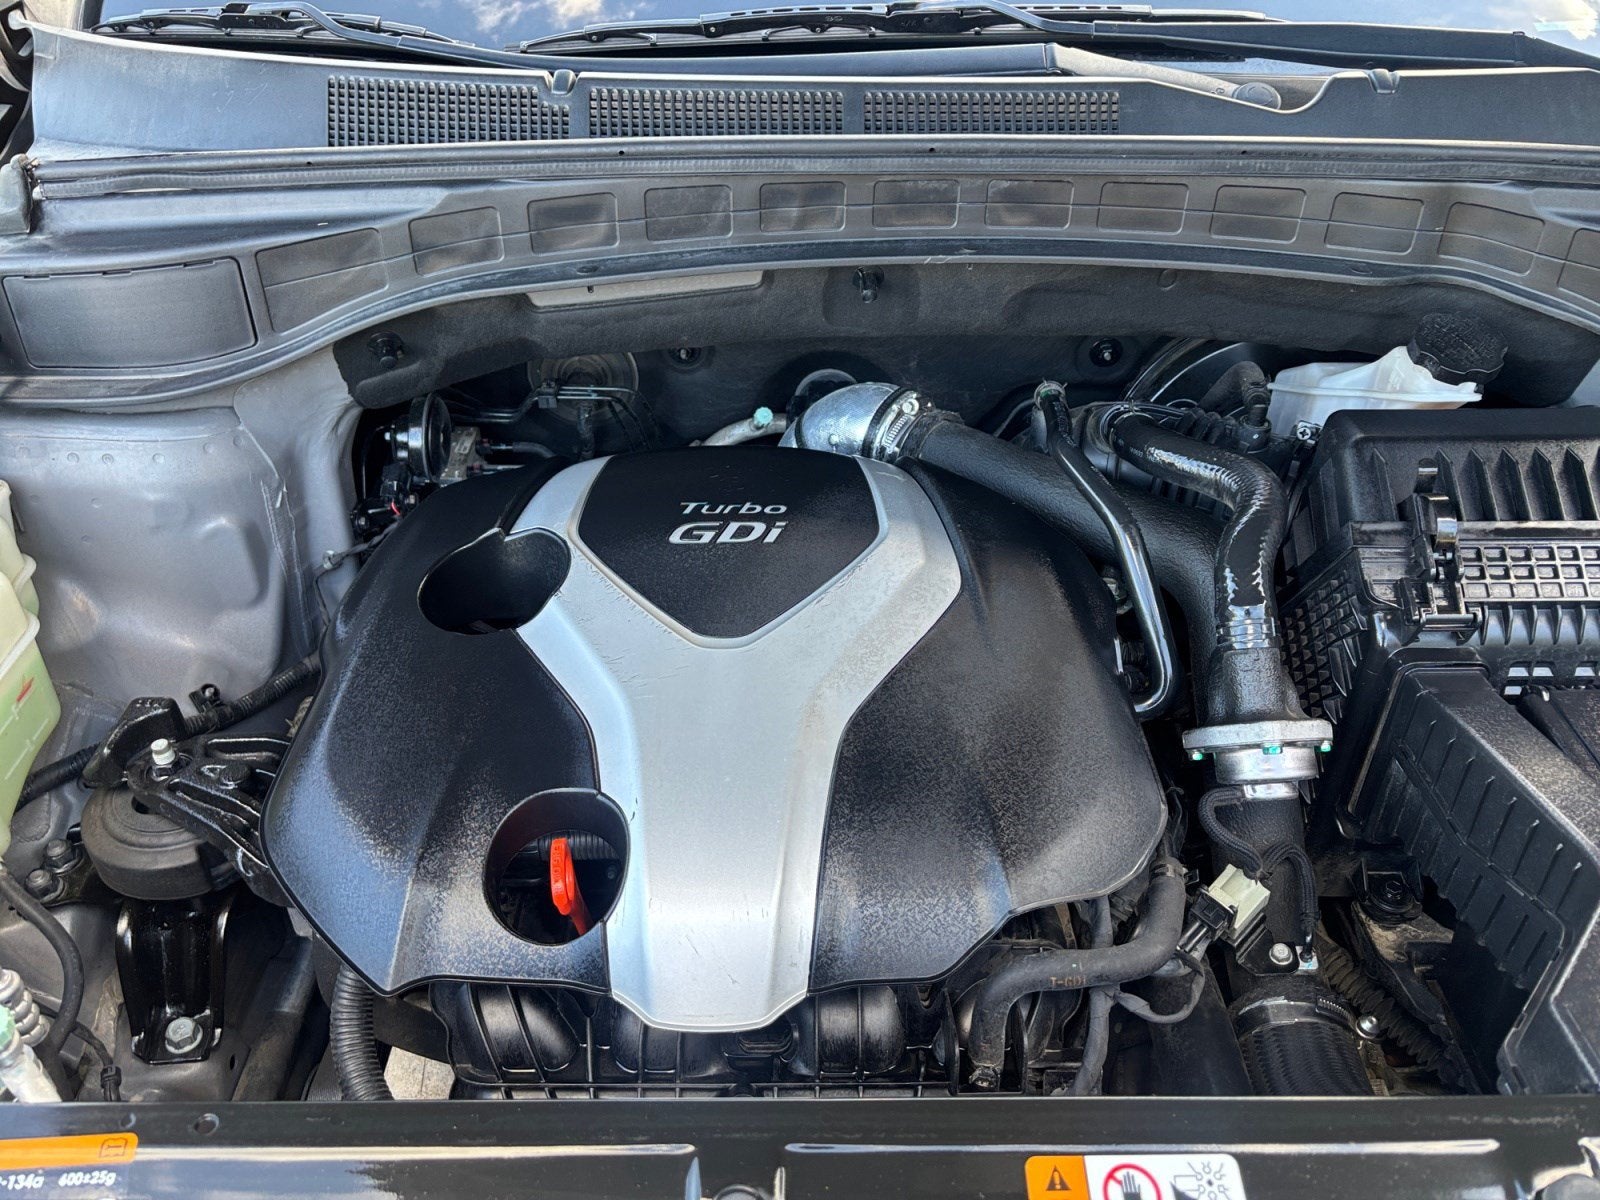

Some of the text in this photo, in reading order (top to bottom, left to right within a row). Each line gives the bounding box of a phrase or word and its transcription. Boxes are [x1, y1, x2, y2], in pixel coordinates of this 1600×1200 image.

[680, 501, 788, 514] Turbo
[668, 521, 788, 544] GDi
[0, 1173, 44, 1190] -134a
